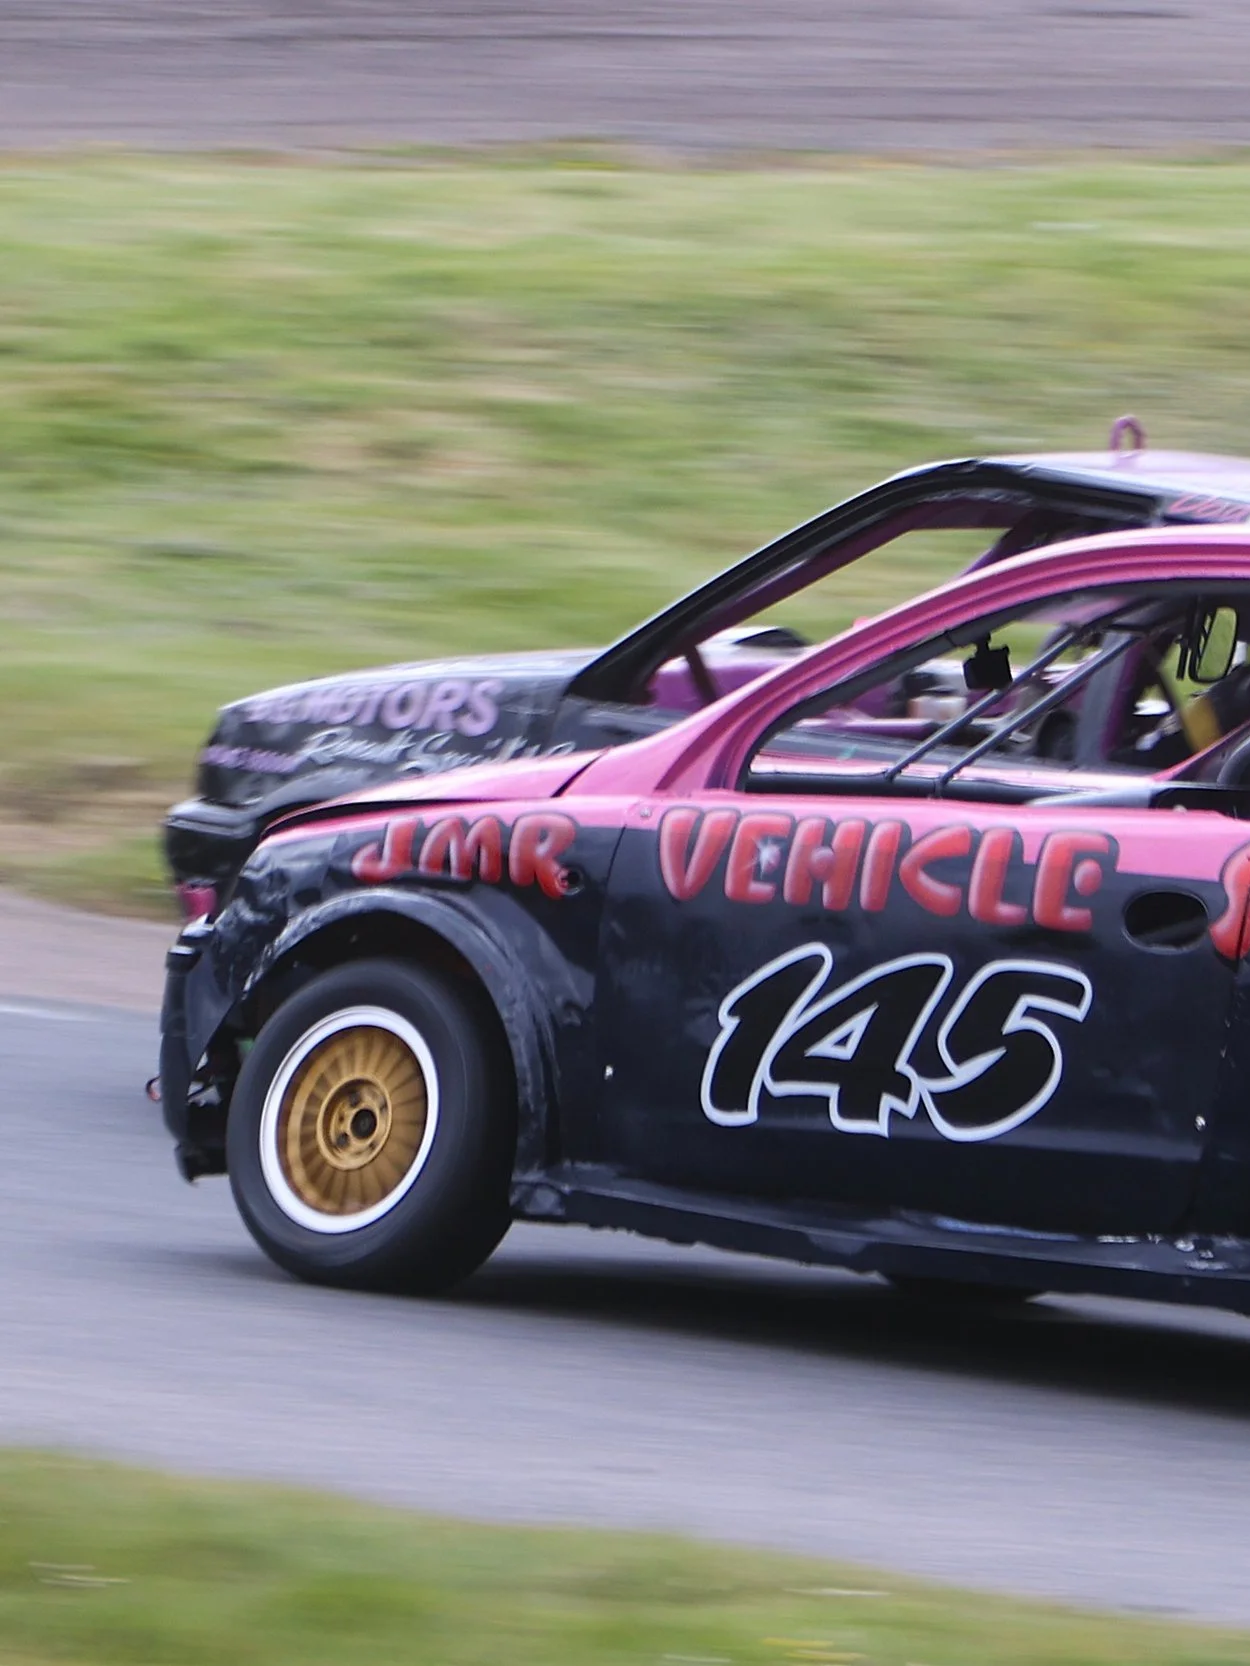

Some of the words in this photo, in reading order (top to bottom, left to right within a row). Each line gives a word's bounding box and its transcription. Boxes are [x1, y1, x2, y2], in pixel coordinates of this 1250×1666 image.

[351, 812, 578, 898] JMR
[658, 806, 1117, 932] VEHICLE
[700, 940, 1094, 1143] 145
